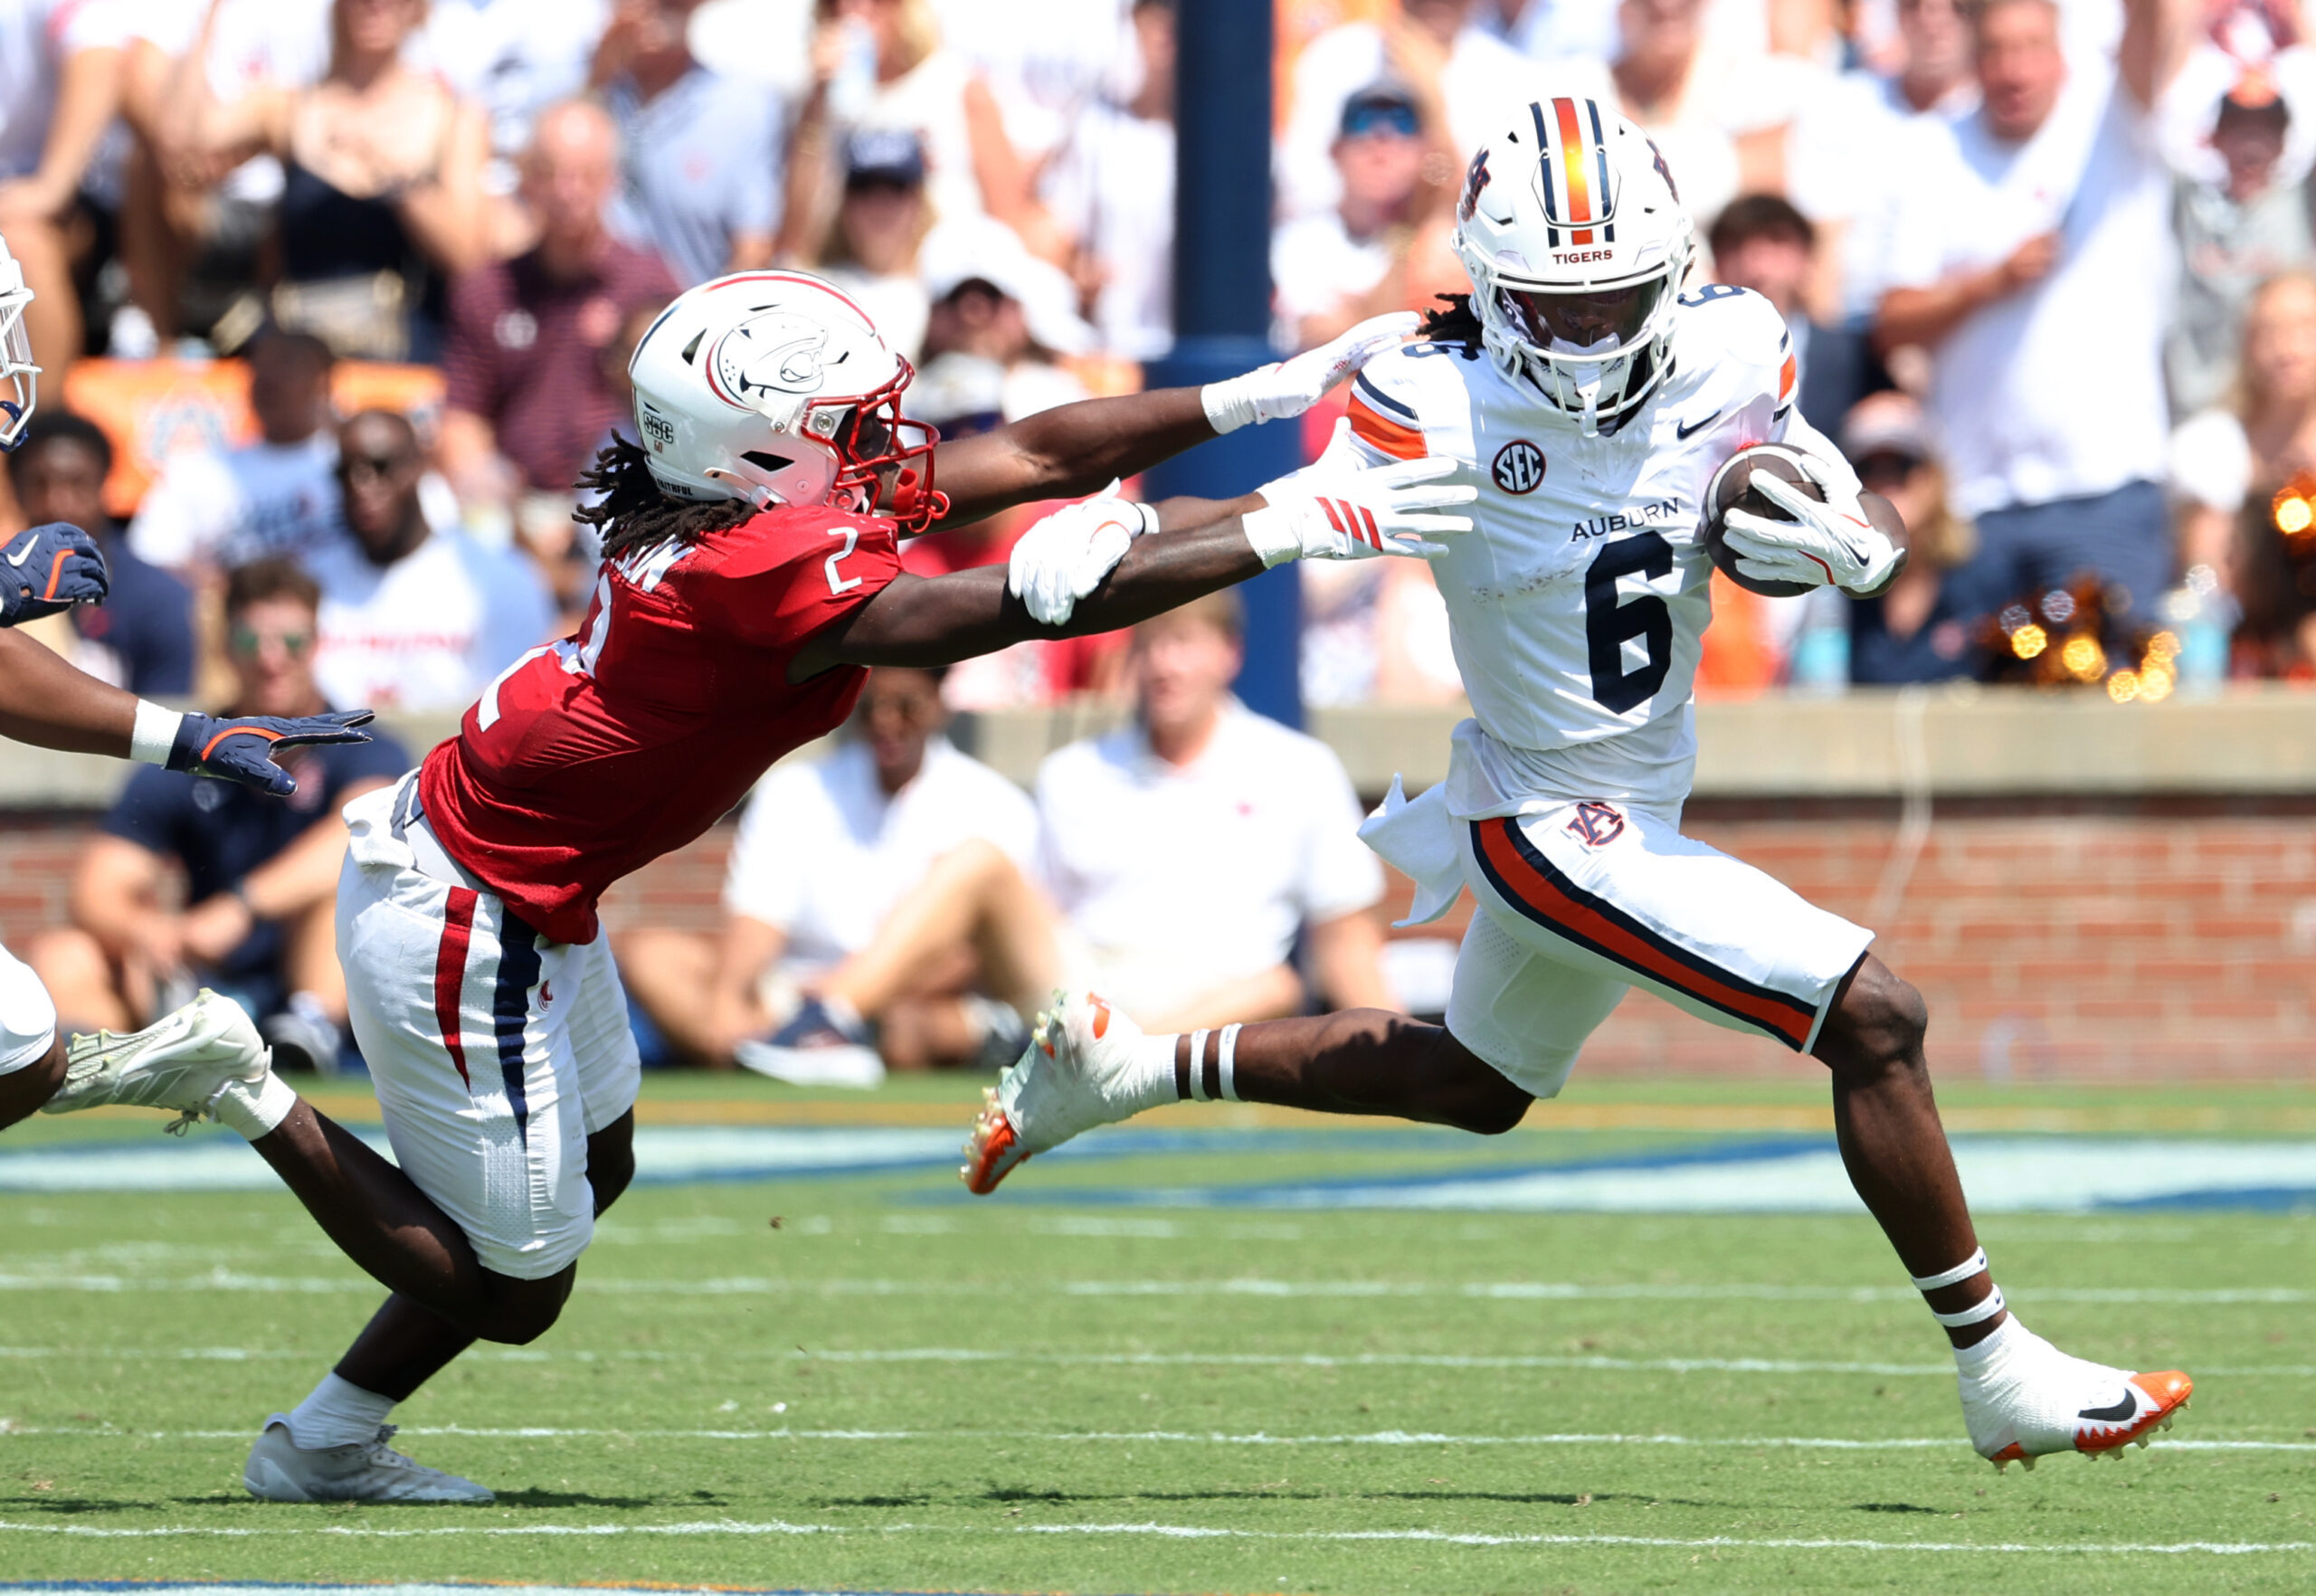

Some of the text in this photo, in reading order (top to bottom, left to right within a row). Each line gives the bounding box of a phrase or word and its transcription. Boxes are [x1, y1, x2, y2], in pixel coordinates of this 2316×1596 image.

[1552, 250, 1613, 264] TIGERS
[643, 412, 674, 443] SBC
[1495, 443, 1542, 491] SEC
[1571, 498, 1679, 542] AUBURN
[824, 527, 862, 596] 2
[1585, 529, 1674, 715] 6
